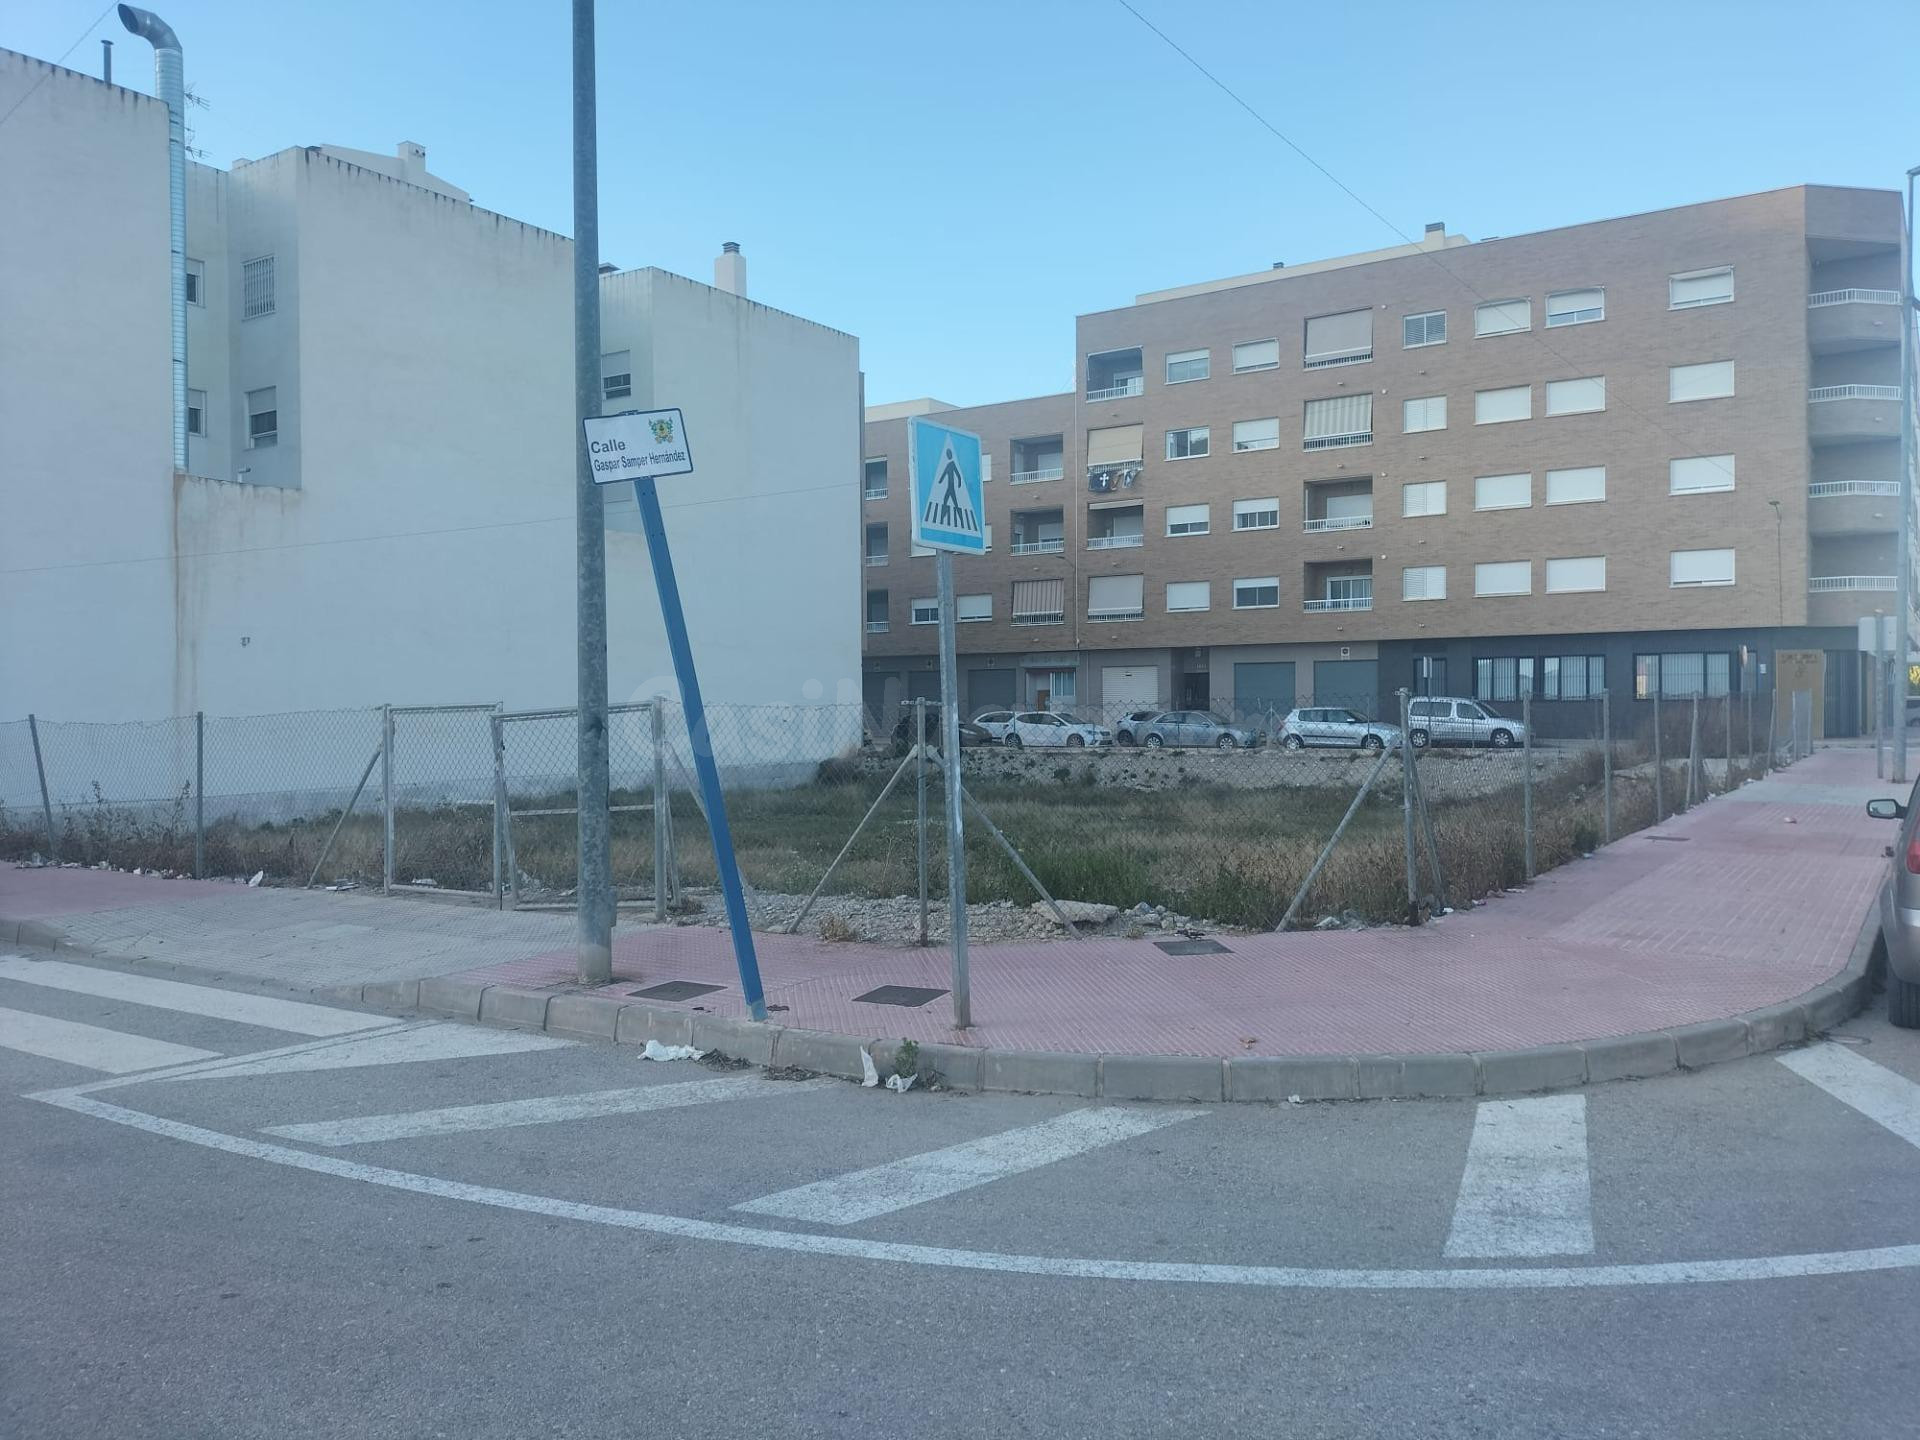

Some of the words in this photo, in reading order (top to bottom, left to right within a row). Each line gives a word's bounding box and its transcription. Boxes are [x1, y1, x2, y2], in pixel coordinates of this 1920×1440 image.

[591, 439, 626, 454] Calle
[594, 459, 620, 473] Gaspar
[621, 456, 648, 469] Samper
[649, 450, 686, 465] Hernández
